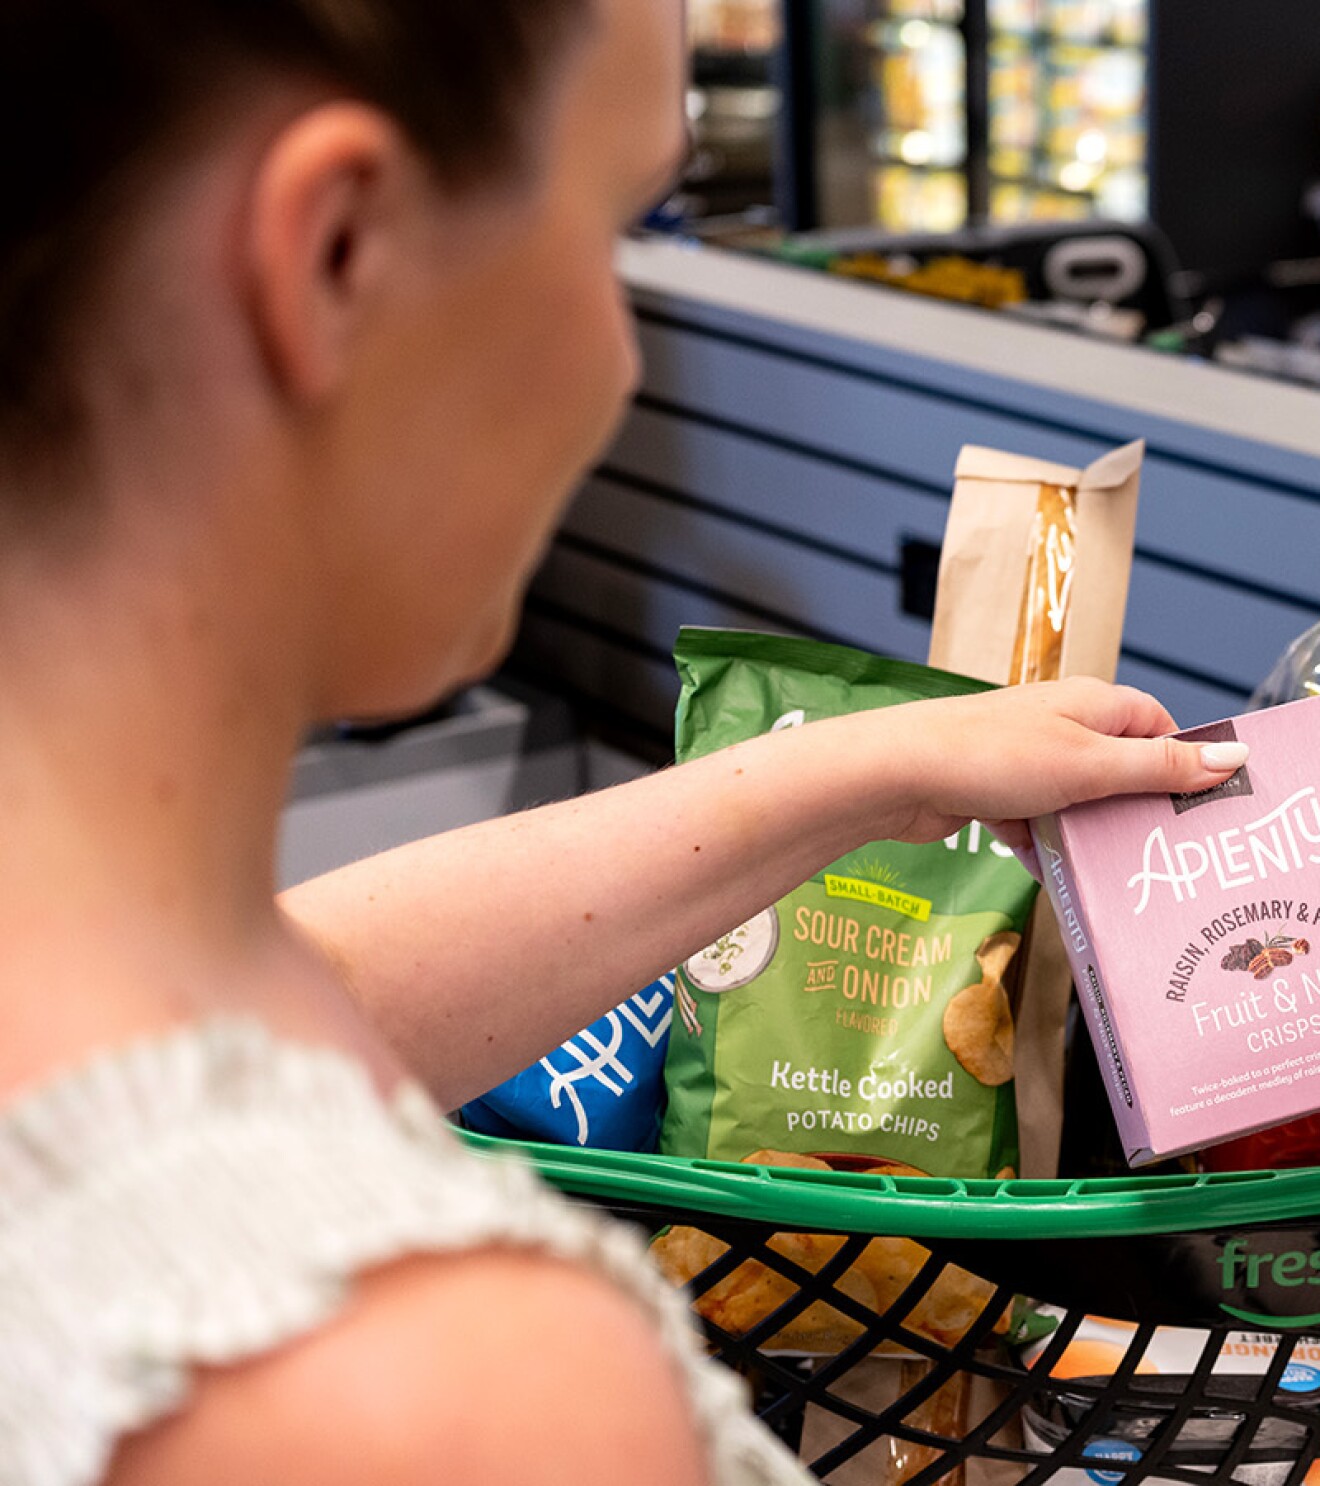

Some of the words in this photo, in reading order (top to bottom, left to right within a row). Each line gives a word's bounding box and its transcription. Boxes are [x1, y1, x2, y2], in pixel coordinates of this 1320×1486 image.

[829, 879, 920, 915] SMALL-BATCH
[794, 905, 859, 954] SOUR
[865, 924, 952, 967] CREAM
[1166, 942, 1210, 1002] RAISIN,
[1200, 900, 1294, 945] ROSEMARY
[1296, 902, 1309, 922] &
[807, 965, 837, 985] AND
[842, 965, 932, 1009] ONION
[1191, 991, 1268, 1036] Fruit
[1271, 978, 1298, 1015] &
[835, 1009, 898, 1036] FLAVORED
[771, 1060, 851, 1097] Kettle
[858, 1072, 954, 1100] Cooked
[1169, 1100, 1204, 1117] feature
[1205, 1097, 1213, 1107] a
[1213, 1084, 1258, 1104] decadent
[1258, 1074, 1293, 1090] medley
[1293, 1067, 1303, 1080] of
[1190, 1071, 1251, 1096] Twice-baked
[1250, 1069, 1263, 1079] to
[1262, 1067, 1270, 1075] a
[1270, 1056, 1305, 1075] perfect
[787, 1110, 873, 1131] POTATO
[880, 1112, 941, 1142] CHIPS
